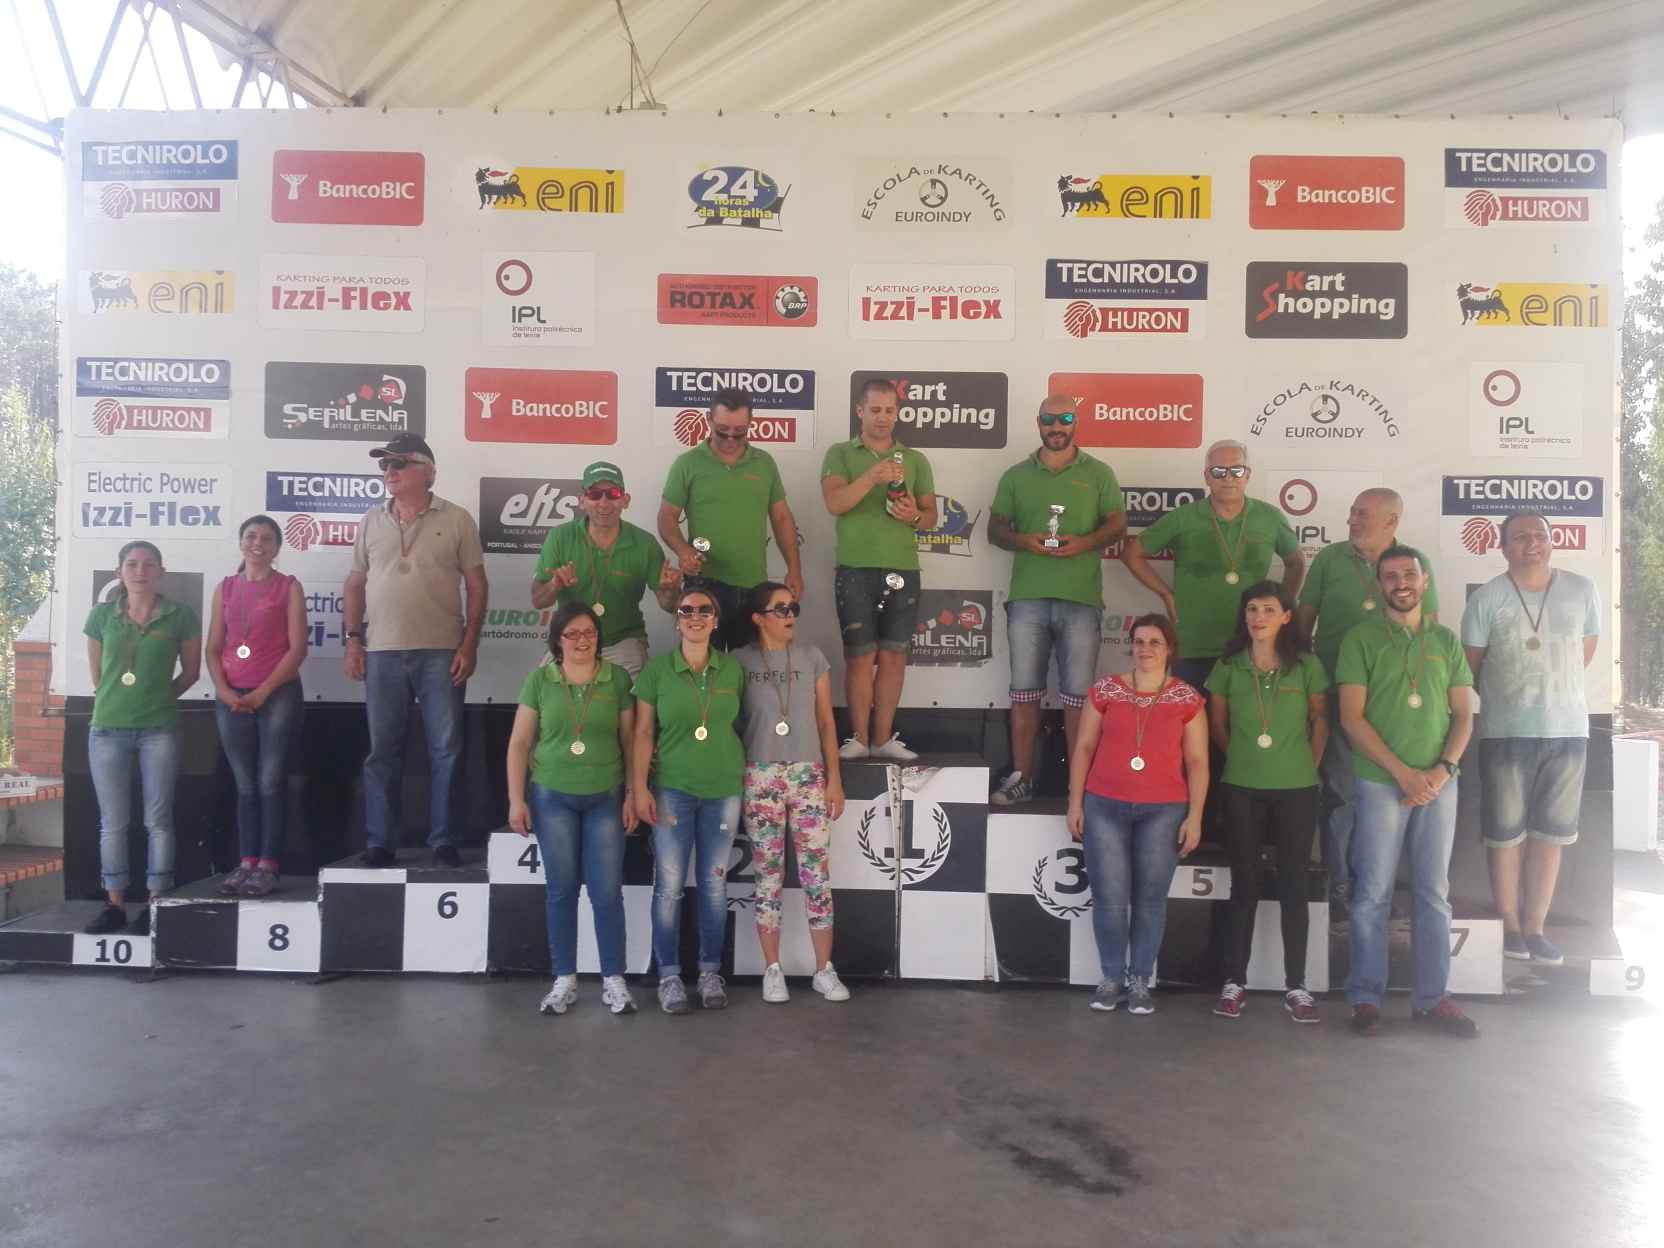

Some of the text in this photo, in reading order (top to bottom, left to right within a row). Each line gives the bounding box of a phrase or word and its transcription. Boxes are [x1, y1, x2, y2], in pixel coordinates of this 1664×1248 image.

[92, 144, 227, 166] TECNIROLO
[1455, 152, 1595, 173] TECNIROLO
[319, 180, 415, 200] BancoBIC
[536, 169, 615, 213] eni
[701, 168, 758, 202] 24
[861, 166, 921, 221] ESCOLA
[937, 164, 1006, 221] KARTING
[1296, 185, 1395, 204] BancoBIC
[141, 190, 214, 211] HURON
[714, 196, 750, 206] horas
[1120, 175, 1200, 219] eni
[698, 207, 774, 218] da Batalha
[895, 210, 972, 223] EUROINDY
[1507, 199, 1582, 219] HURON
[1057, 262, 1198, 285] TECNIROLO
[1285, 271, 1346, 292] Kart
[148, 270, 225, 314] eni
[271, 285, 413, 312] Izzi-Flex
[670, 290, 756, 310] ROTAX
[865, 284, 1000, 294] KARTING PARA TODOS
[787, 302, 808, 310] BRP
[861, 295, 1003, 321] Izzi-Flex
[1256, 282, 1396, 321] Shopping
[1519, 284, 1599, 327] eni
[511, 305, 547, 324] IPL
[1107, 311, 1182, 331] HURON
[86, 361, 221, 384] TECNIROLO
[666, 371, 804, 394] TECNIROLO
[131, 408, 205, 429] HURON
[511, 399, 609, 419] BancoBIC
[894, 403, 996, 430] opping
[1094, 403, 1193, 422] BancoBIC
[1250, 382, 1313, 436] ESCOLA
[1329, 380, 1400, 438] KARTING
[746, 420, 789, 440] RON
[1285, 426, 1365, 439] EUROINDY
[1499, 416, 1535, 435] IPL
[87, 472, 218, 494] Electric Power
[277, 475, 392, 499] TECNIRO
[1453, 479, 1594, 501] TECNIROLO
[1122, 491, 1195, 512] IROLO
[80, 501, 223, 528] Izzi-Flex
[1295, 525, 1332, 544] IPL
[305, 591, 345, 613] ctric
[480, 630, 539, 640] artodromo
[517, 843, 542, 874] 4
[726, 836, 757, 878] 2
[1053, 847, 1087, 895] 3
[1191, 868, 1213, 897] 5
[437, 890, 459, 920] 6
[267, 923, 290, 952] 8
[1449, 927, 1471, 957] 7
[94, 938, 133, 965] 10
[1624, 965, 1646, 991] 9
